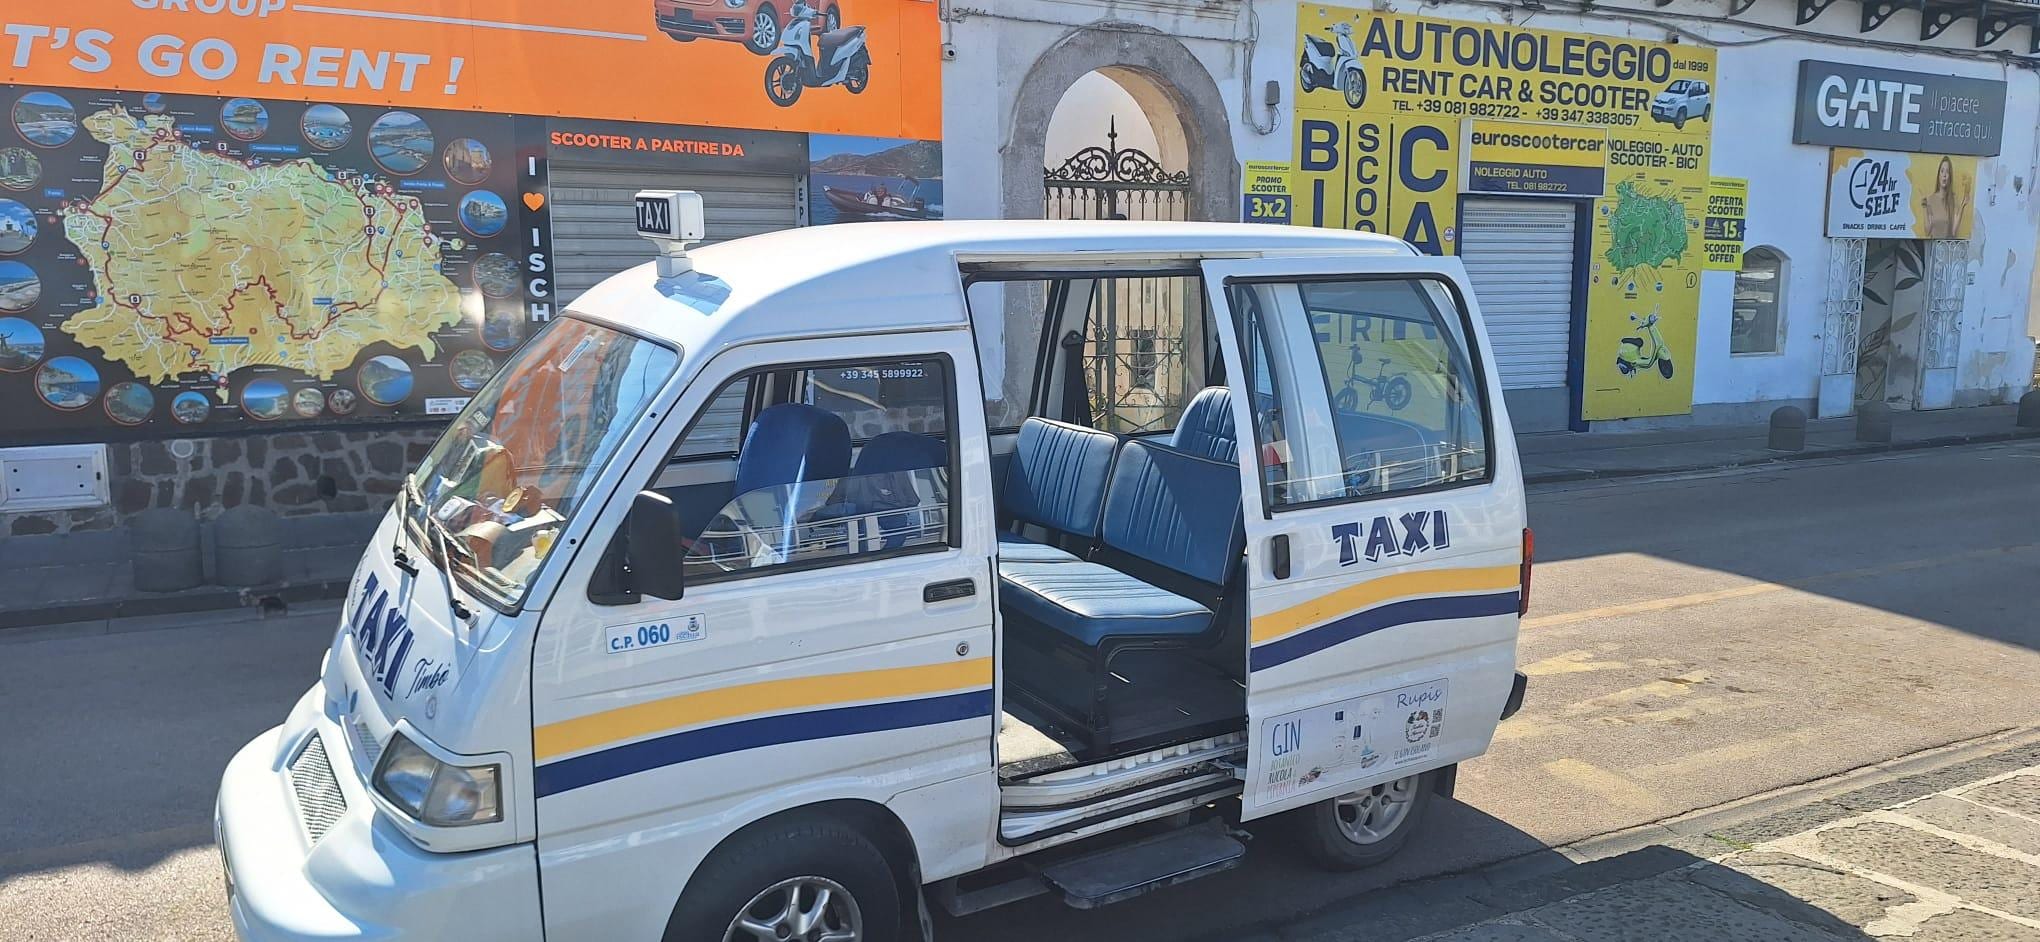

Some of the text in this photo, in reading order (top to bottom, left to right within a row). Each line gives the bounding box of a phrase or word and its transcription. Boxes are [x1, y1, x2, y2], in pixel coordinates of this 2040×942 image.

[1361, 17, 1709, 83] AUTONOLEGGIO dal 1999
[137, 34, 238, 81] GO
[257, 43, 431, 92] RENT
[443, 56, 464, 95] !
[1382, 67, 1650, 111] RENT CAR & SCOOTER
[1930, 89, 1980, 115] Il piacere
[1392, 100, 1414, 112] TEL.
[1416, 100, 1441, 113] +39
[1444, 102, 1467, 115] 081
[1469, 103, 1520, 118] 982722
[1535, 108, 1559, 121] +39
[1561, 109, 1583, 122] 347
[1586, 110, 1640, 126] 3383057
[1816, 74, 1925, 134] GATE
[1471, 131, 1604, 152] euroscootercar
[1928, 117, 1993, 144] attracca qui.
[551, 131, 744, 157] SCOOTER A PARTIRE DA
[1606, 139, 1662, 154] NOLEGGIO
[1672, 144, 1703, 157] AUTO
[1474, 167, 1547, 180] NOLEGGIO AUTO
[1610, 152, 1667, 168] SCOOTER
[1676, 156, 1698, 170] BICI
[1251, 184, 1287, 193] SCOOTER
[1256, 176, 1282, 184] PROMO
[1250, 197, 1286, 218] 3x2
[1707, 205, 1744, 217] SCOOTER
[1709, 195, 1744, 206] OFFERTA
[1864, 192, 1900, 218] SELF
[636, 201, 671, 230] TAXI
[1704, 243, 1741, 254] SCOOTER
[1709, 253, 1735, 264] OFFER
[529, 228, 550, 322] ISCH
[840, 369, 923, 380] +39 345 5899922
[1331, 510, 1450, 567] TAXI
[350, 571, 416, 702] TAXI
[611, 636, 634, 650] C.P.
[637, 623, 670, 646] 060
[1396, 686, 1443, 709] Rupis
[1272, 718, 1302, 757] GIN
